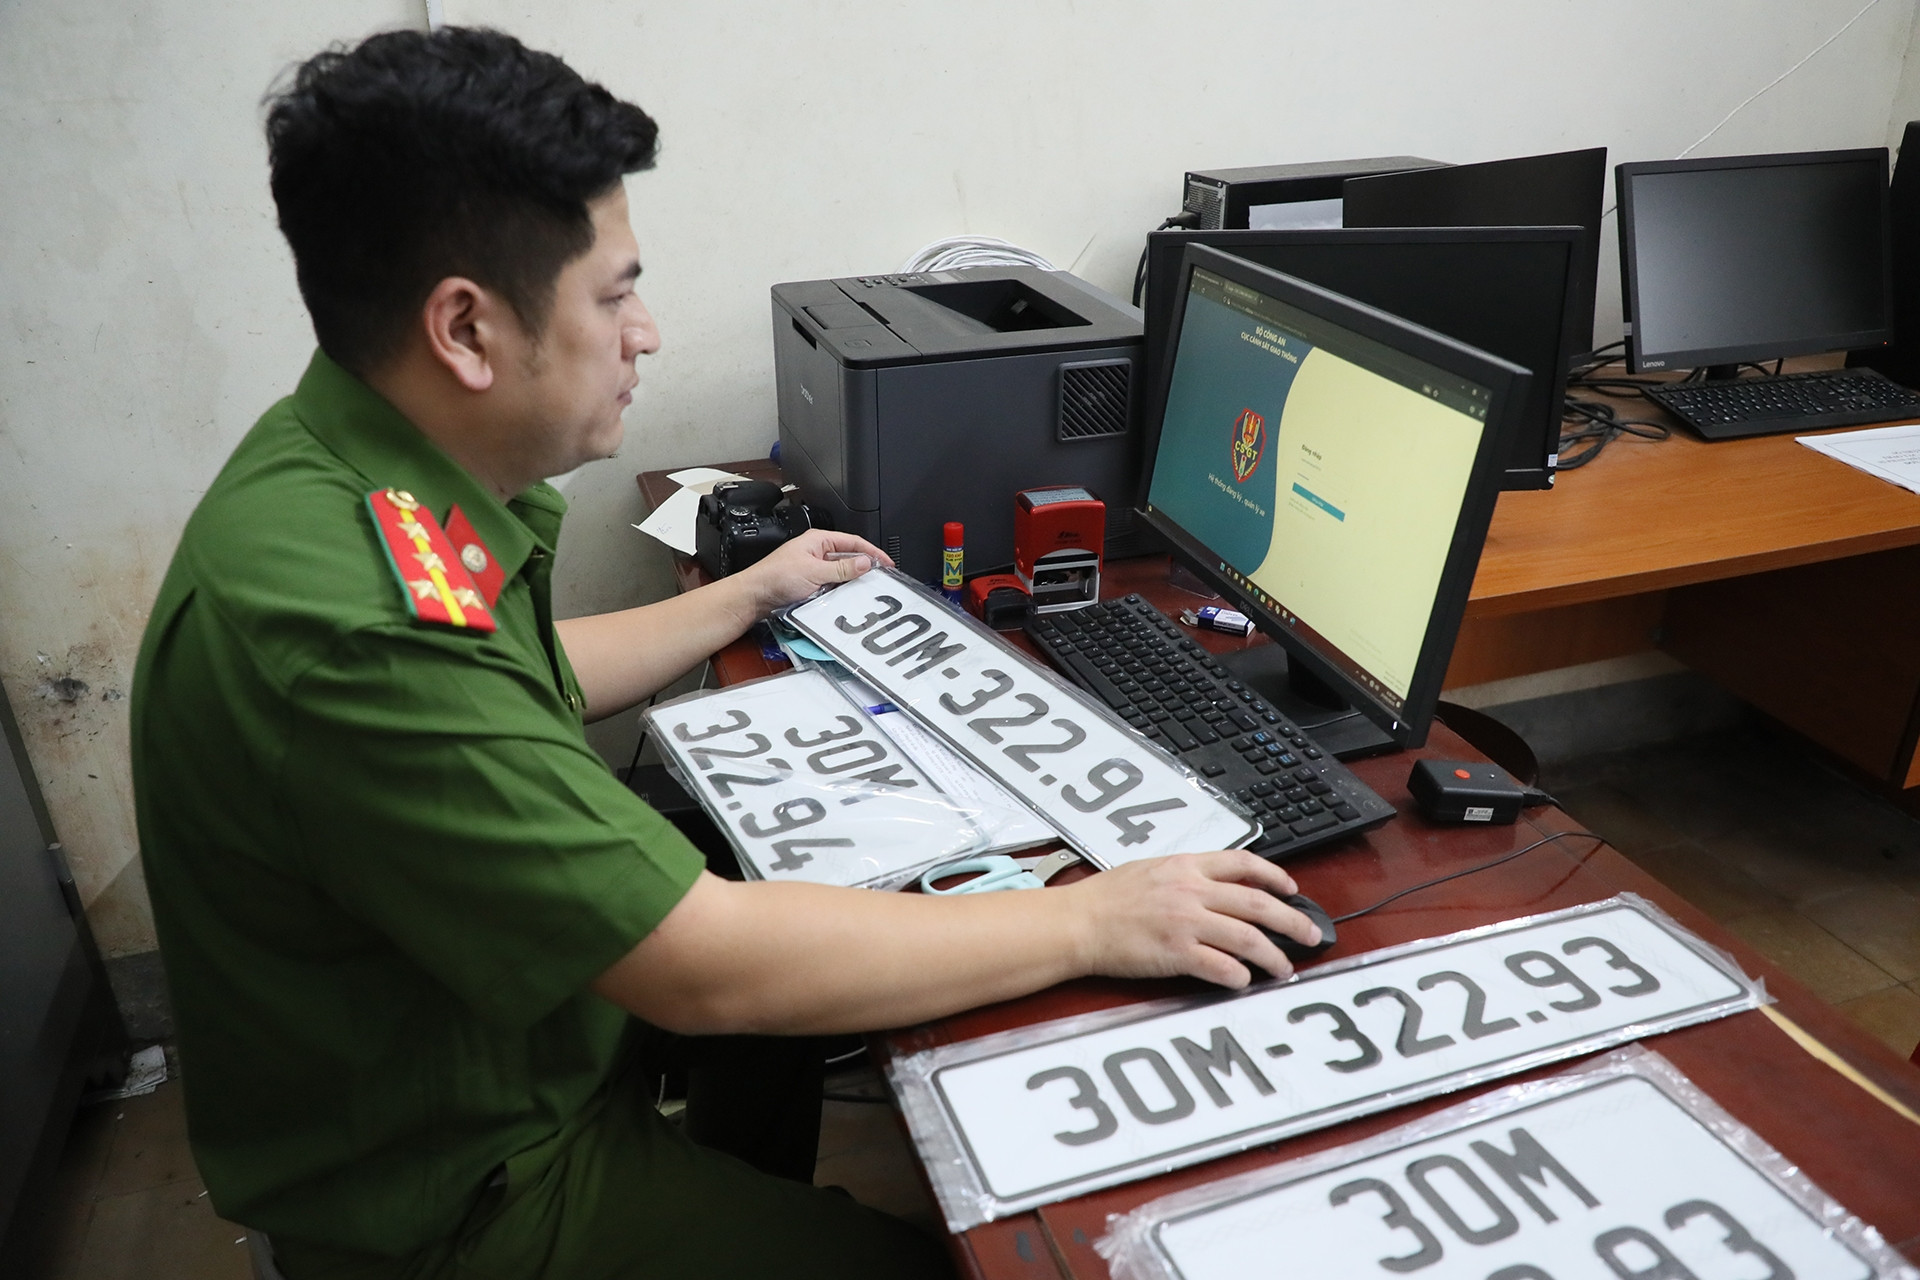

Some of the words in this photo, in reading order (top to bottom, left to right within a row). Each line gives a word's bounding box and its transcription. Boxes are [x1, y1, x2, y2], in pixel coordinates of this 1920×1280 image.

[1263, 329, 1278, 343] CÔNG
[1277, 336, 1287, 347] AN
[1642, 360, 1666, 369] Lenovo
[1234, 440, 1258, 461] CSGT
[672, 709, 856, 871] 322.94
[834, 595, 1188, 847] 30M-322.94
[1025, 935, 1662, 1147] 30M-322.93
[1328, 1127, 1604, 1273] 30M
